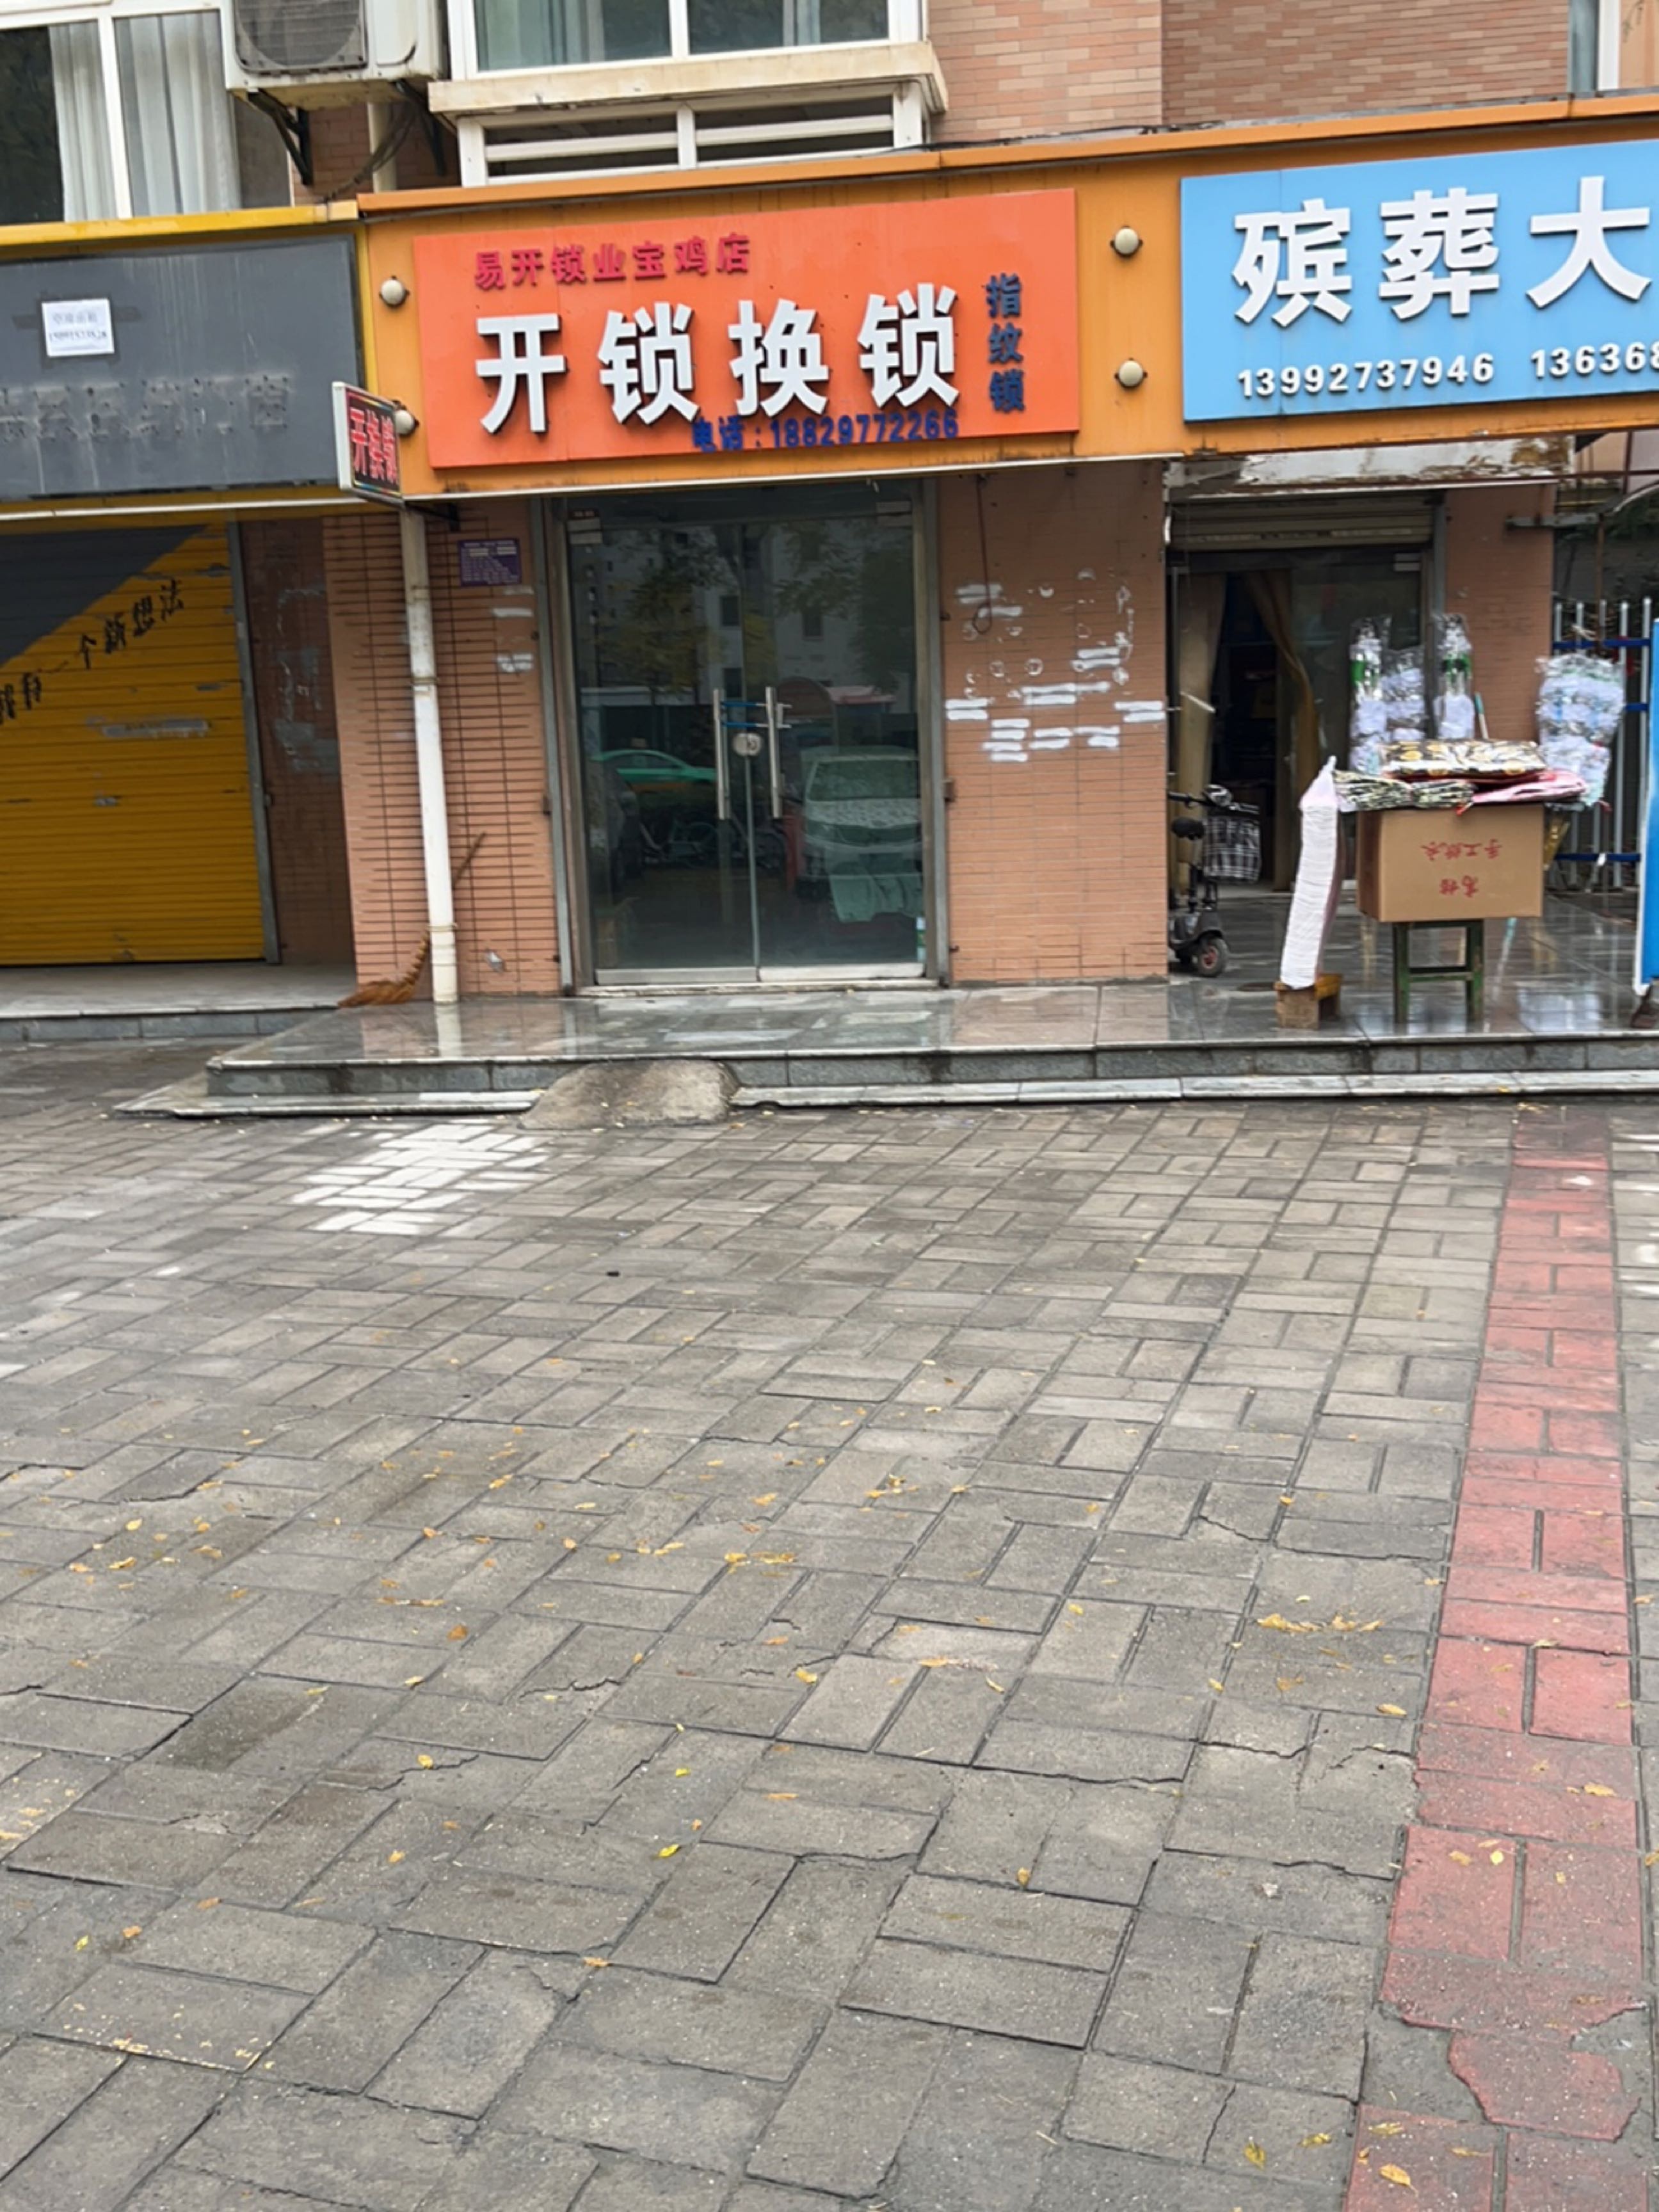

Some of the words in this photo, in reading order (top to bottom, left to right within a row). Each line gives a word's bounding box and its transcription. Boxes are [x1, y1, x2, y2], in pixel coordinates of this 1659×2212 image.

[474, 232, 750, 289] 易开锁业宝鸡店
[1233, 177, 1651, 328] 殡葬大
[475, 282, 961, 436] 开锁换锁
[986, 272, 1025, 413] 指纹锁
[1238, 353, 1496, 398] 13992737946
